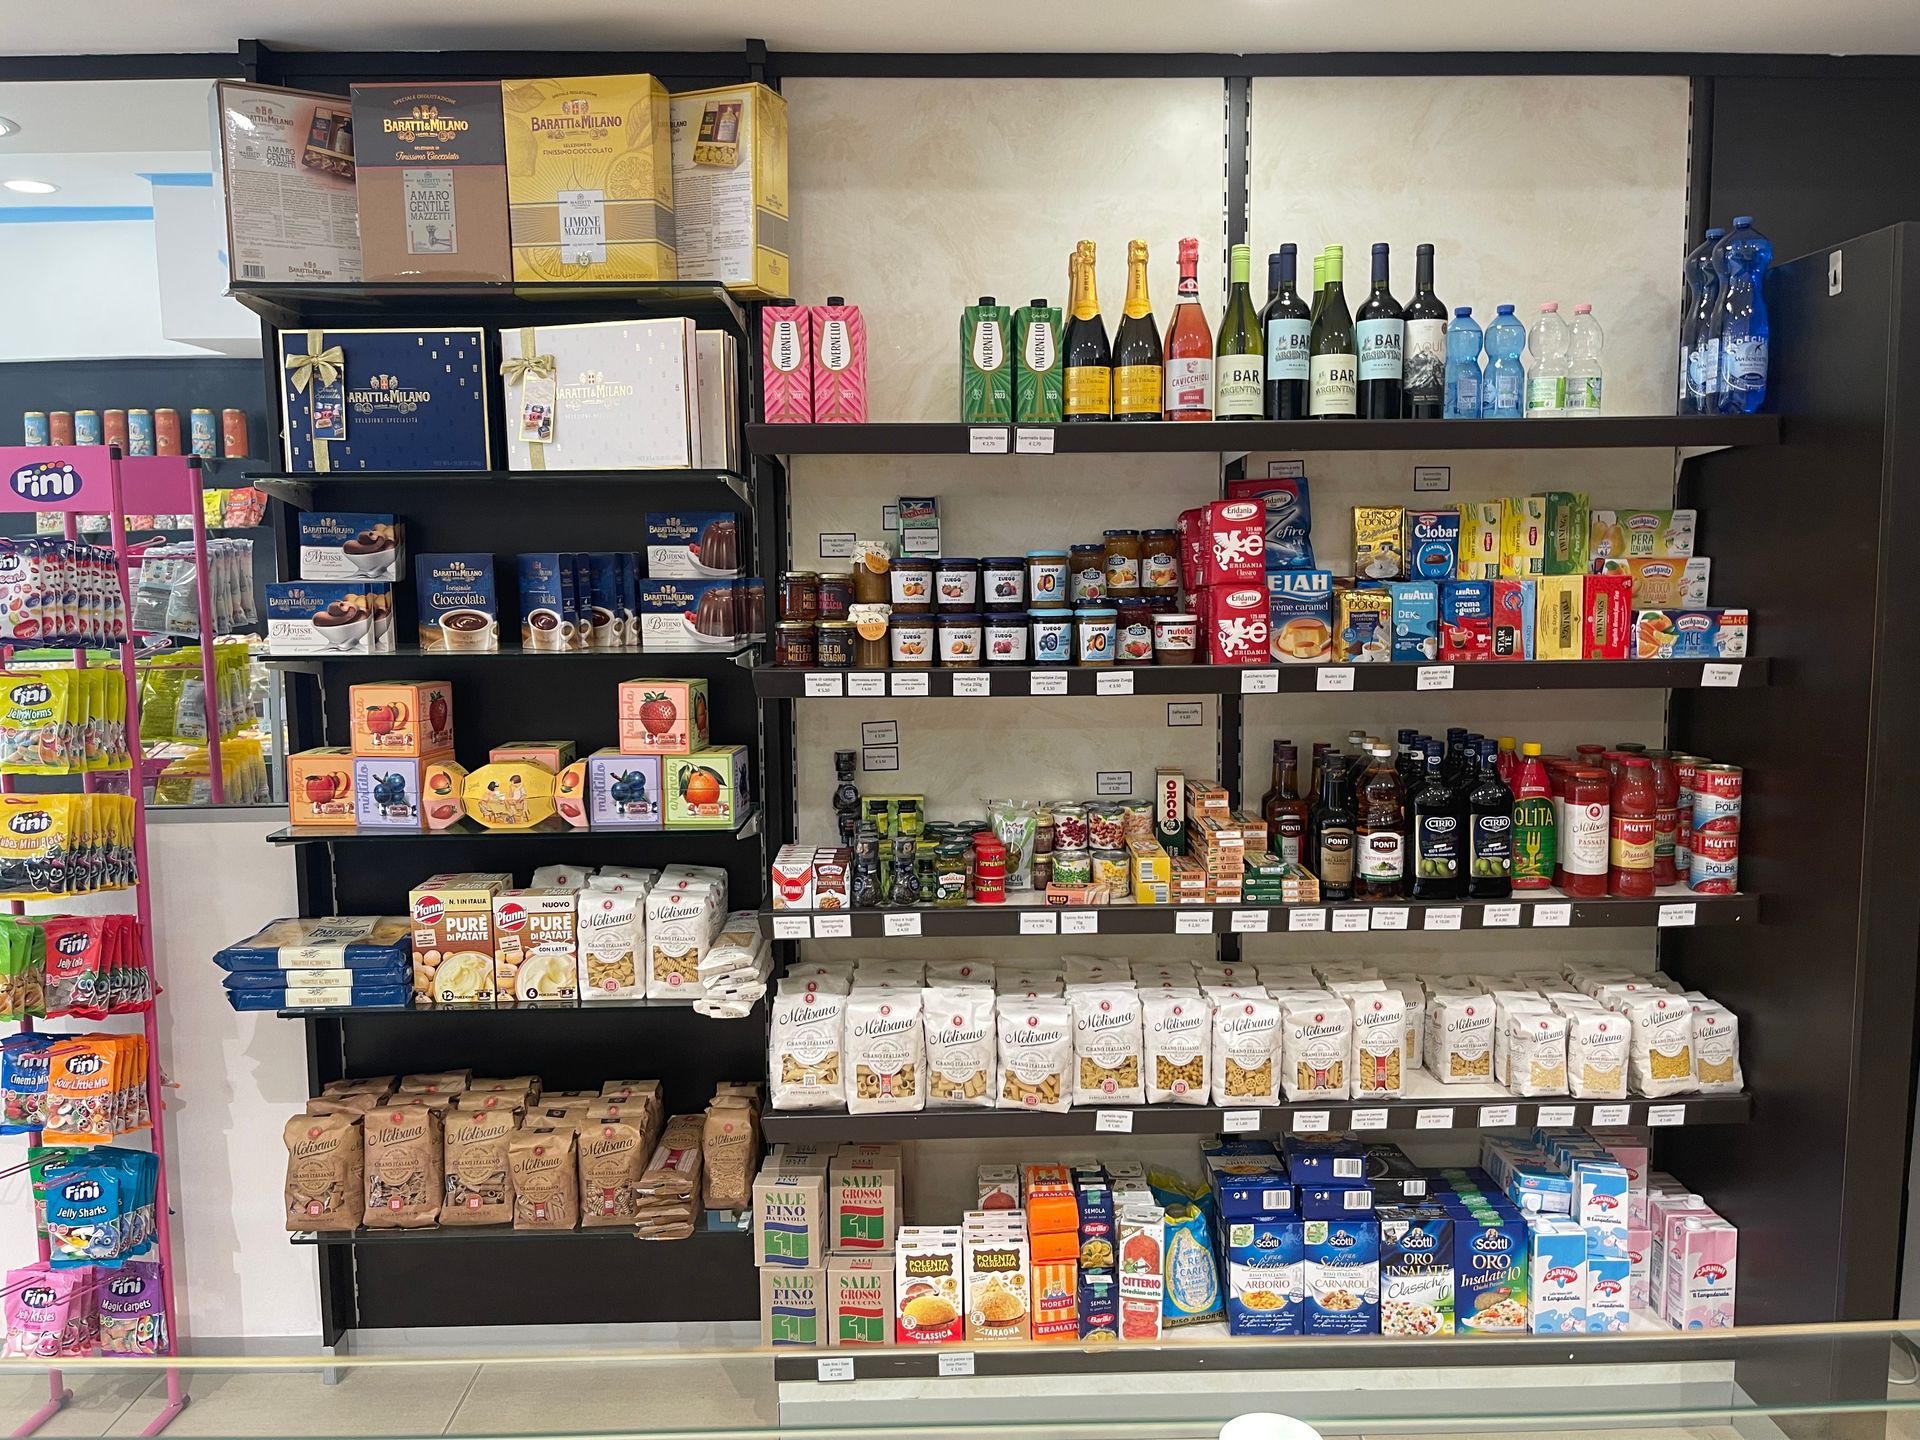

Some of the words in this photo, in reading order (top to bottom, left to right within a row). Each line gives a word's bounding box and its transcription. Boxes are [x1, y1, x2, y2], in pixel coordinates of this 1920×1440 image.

[383, 119, 469, 133] BARATTI&MILANO
[531, 116, 622, 132] BARATTI&MILANO
[572, 147, 613, 155] CIOCCOLATO
[266, 152, 296, 163] GENTILE
[410, 191, 449, 201] AMARO
[410, 201, 450, 212] GENTILE
[410, 212, 450, 221] MAZZETTI
[564, 215, 600, 227] LIMONE
[564, 226, 601, 236] MAZZETTI
[781, 322, 791, 369] TAVERNELLO
[831, 322, 841, 368] TAVERNELLO
[982, 322, 993, 369] TAVERNELLO
[1034, 323, 1045, 369] TAVERNELLO
[1375, 335, 1400, 346] BAR
[1172, 373, 1210, 388] CAVICCHIOLI
[1233, 370, 1259, 384] BAR
[1330, 369, 1354, 382] BAR
[17, 466, 74, 497] Fini
[1227, 506, 1253, 515] Eridania
[1630, 518, 1658, 526] sterilgarda
[303, 525, 354, 534] BARATTI&MILANO
[649, 526, 698, 534] BARATTI&MILANO
[1414, 525, 1458, 538] Ciobar
[1560, 514, 1568, 552] TWININGS
[1631, 534, 1654, 545] PERA
[1425, 543, 1446, 552] CLASSICO
[1631, 544, 1653, 552] ITALIANA
[433, 569, 482, 578] BARATTI&MILANO
[1643, 567, 1671, 576] sterilgarda
[1268, 575, 1328, 591] ELAH
[433, 593, 486, 606] Cioccolata
[643, 593, 694, 601] BARATTI&MILANO
[1231, 593, 1257, 603] Eridania
[1400, 591, 1434, 600] LAVAZZA
[270, 598, 323, 606] BARATTI&MILANO
[1595, 601, 1604, 637] TWININGS
[1678, 619, 1708, 629] sterilgarda
[1497, 630, 1505, 653] STAR
[1505, 635, 1512, 646] TE
[1684, 632, 1700, 645] ACE
[13, 685, 47, 702] Fini
[357, 698, 365, 734] pesca
[360, 764, 369, 813] mirtillo
[1166, 780, 1176, 819] ORCO
[12, 814, 49, 831] Fini
[1483, 818, 1510, 826] CIRIO
[1514, 807, 1554, 826] OLITA
[1428, 819, 1454, 827] CIRIO
[1623, 824, 1652, 833] MUTTI
[1373, 841, 1396, 849] PONTI
[1705, 839, 1736, 848] MUTTI
[414, 900, 444, 917] Pfanni
[496, 908, 527, 925] Pfanni
[530, 914, 572, 930] PURÈ
[446, 914, 488, 932] PURÈ
[455, 932, 488, 941] PATATE
[540, 931, 572, 940] PATATE
[59, 934, 87, 951] Fini
[57, 958, 71, 969] Jelly
[72, 957, 83, 968] Cola
[444, 992, 452, 1000] 12
[69, 1055, 100, 1072] Fini
[10, 1073, 36, 1085] Cinema
[54, 1079, 70, 1088] Sour
[71, 1078, 93, 1089] Little
[842, 1176, 882, 1188] SALE
[65, 1181, 100, 1199] Fini
[842, 1189, 882, 1198] GROSSO
[766, 1193, 806, 1205] SALE
[1589, 1195, 1619, 1208] CARNINI
[57, 1207, 77, 1218] Jelly
[79, 1206, 107, 1218] Sharks
[766, 1205, 806, 1217] FINO
[1084, 1224, 1107, 1234] Barilla
[1256, 1238, 1279, 1248] Scotti
[1330, 1236, 1354, 1246] Scotti
[1404, 1237, 1433, 1248] Scotti
[1476, 1238, 1507, 1250] Scotti
[909, 1259, 949, 1268] POLENTA
[977, 1255, 1016, 1264] POLENTA
[1403, 1253, 1433, 1264] ORO
[1472, 1254, 1511, 1269] ORO
[1386, 1265, 1449, 1277] INSALATE
[1461, 1270, 1506, 1288] Insalate
[1507, 1266, 1521, 1282] 10
[1545, 1267, 1577, 1282] CARNINI
[1696, 1264, 1727, 1279] CARNINI
[111, 1277, 141, 1294] Fini
[773, 1276, 814, 1288] SALE
[840, 1276, 881, 1288] SALE
[1122, 1276, 1161, 1289] CITTERIO
[1245, 1280, 1290, 1289] ARBORIO
[1315, 1279, 1370, 1289] CARNAROLI
[1387, 1277, 1445, 1298] Classiche
[1595, 1281, 1622, 1294] CARNINI
[24, 1288, 56, 1306] Fini
[774, 1289, 814, 1299] FINO
[841, 1290, 881, 1299] GROSSO
[102, 1300, 122, 1312] Magic
[124, 1299, 151, 1312] Carpets
[1041, 1298, 1073, 1309] MORETTI
[1090, 1315, 1112, 1324] Barilla
[915, 1330, 952, 1339] CLASSICA
[983, 1327, 1021, 1336] TARAGNA
[1038, 1323, 1079, 1334] BRAMATA
